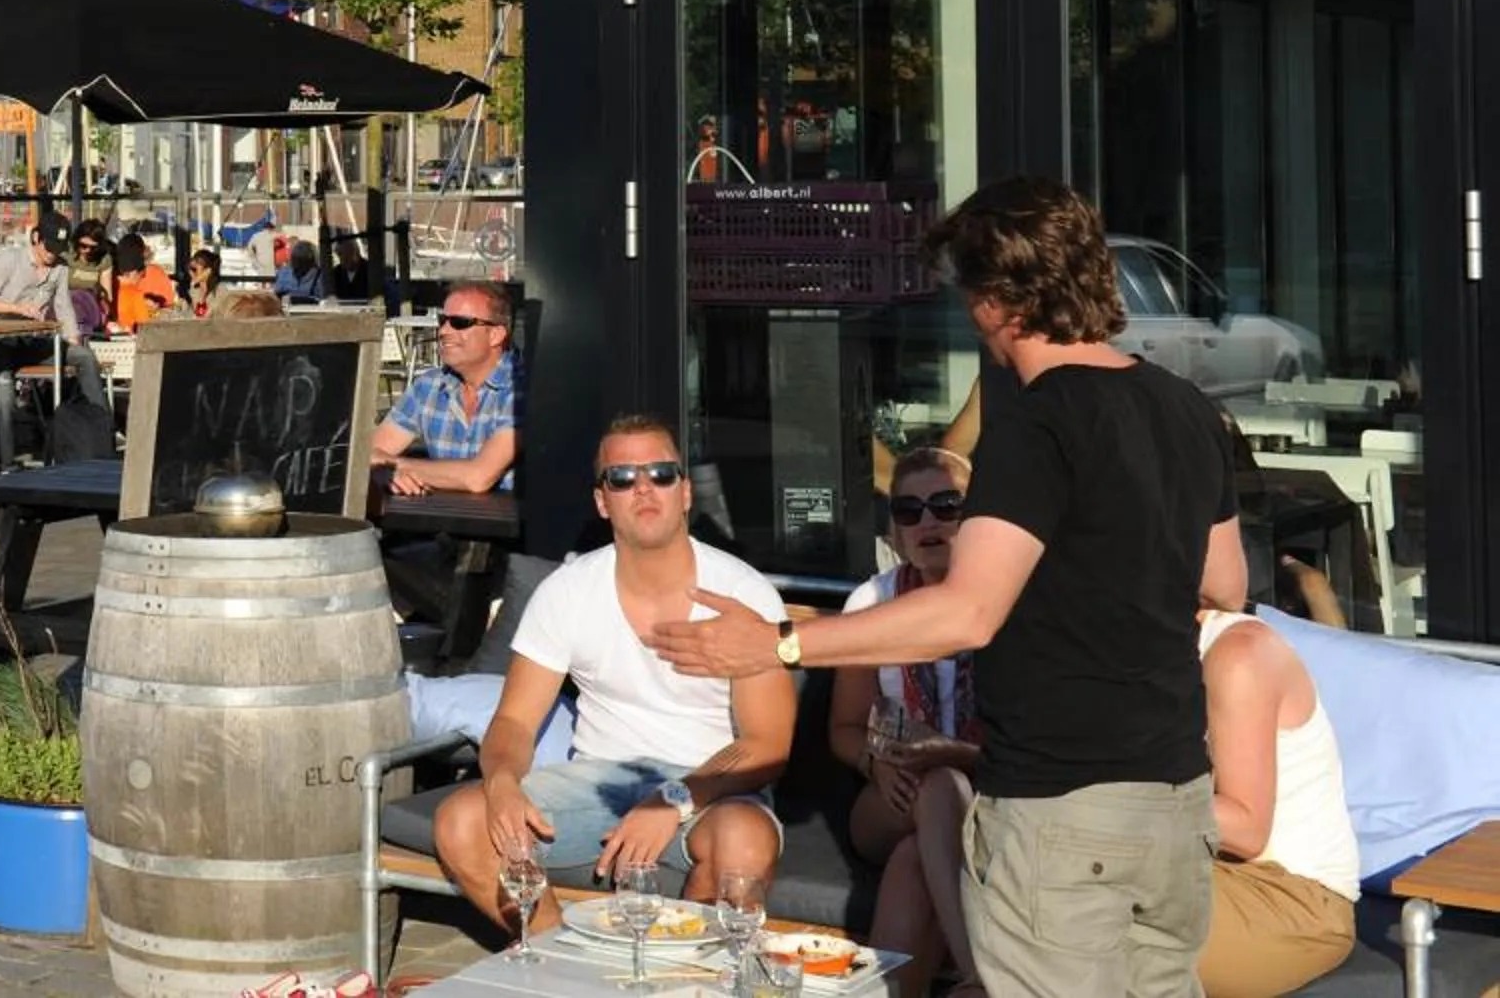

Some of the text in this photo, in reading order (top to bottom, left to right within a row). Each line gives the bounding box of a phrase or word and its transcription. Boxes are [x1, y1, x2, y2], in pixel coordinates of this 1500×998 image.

[715, 185, 811, 199] www.albert.nl
[194, 375, 317, 447] NAP
[305, 765, 332, 787] EL
